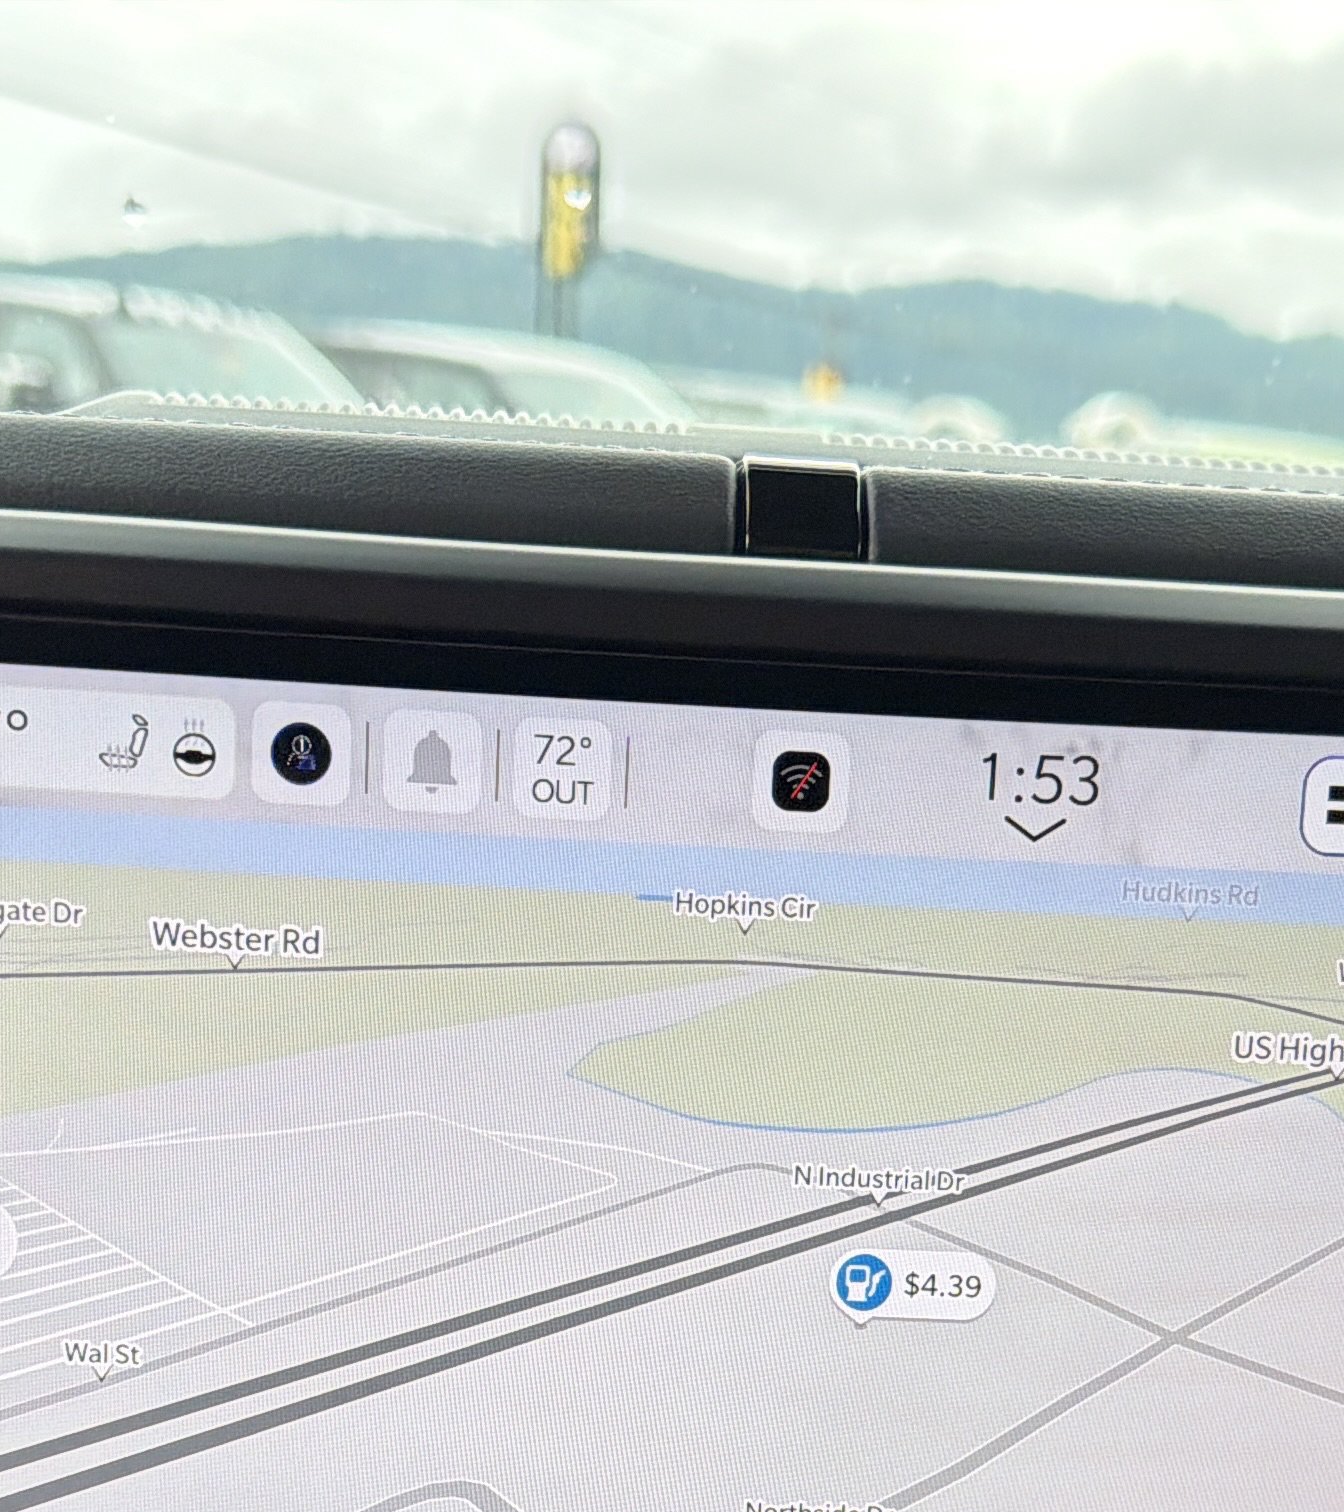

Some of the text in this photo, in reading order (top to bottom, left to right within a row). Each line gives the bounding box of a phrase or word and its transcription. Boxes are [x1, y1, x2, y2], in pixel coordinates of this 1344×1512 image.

[533, 733, 593, 767] 72°
[531, 778, 595, 807] OUT
[980, 752, 1102, 807] 1:53
[674, 892, 817, 921] Hopkins Cir
[1121, 880, 1259, 908] Hudkins Rd
[53, 900, 83, 927] Dr
[152, 920, 321, 956] Webster Rd
[1234, 1035, 1273, 1062] US
[794, 1167, 965, 1192] N Industrial Dr
[904, 1271, 983, 1299] $4.39
[65, 1342, 140, 1366] Wal St
